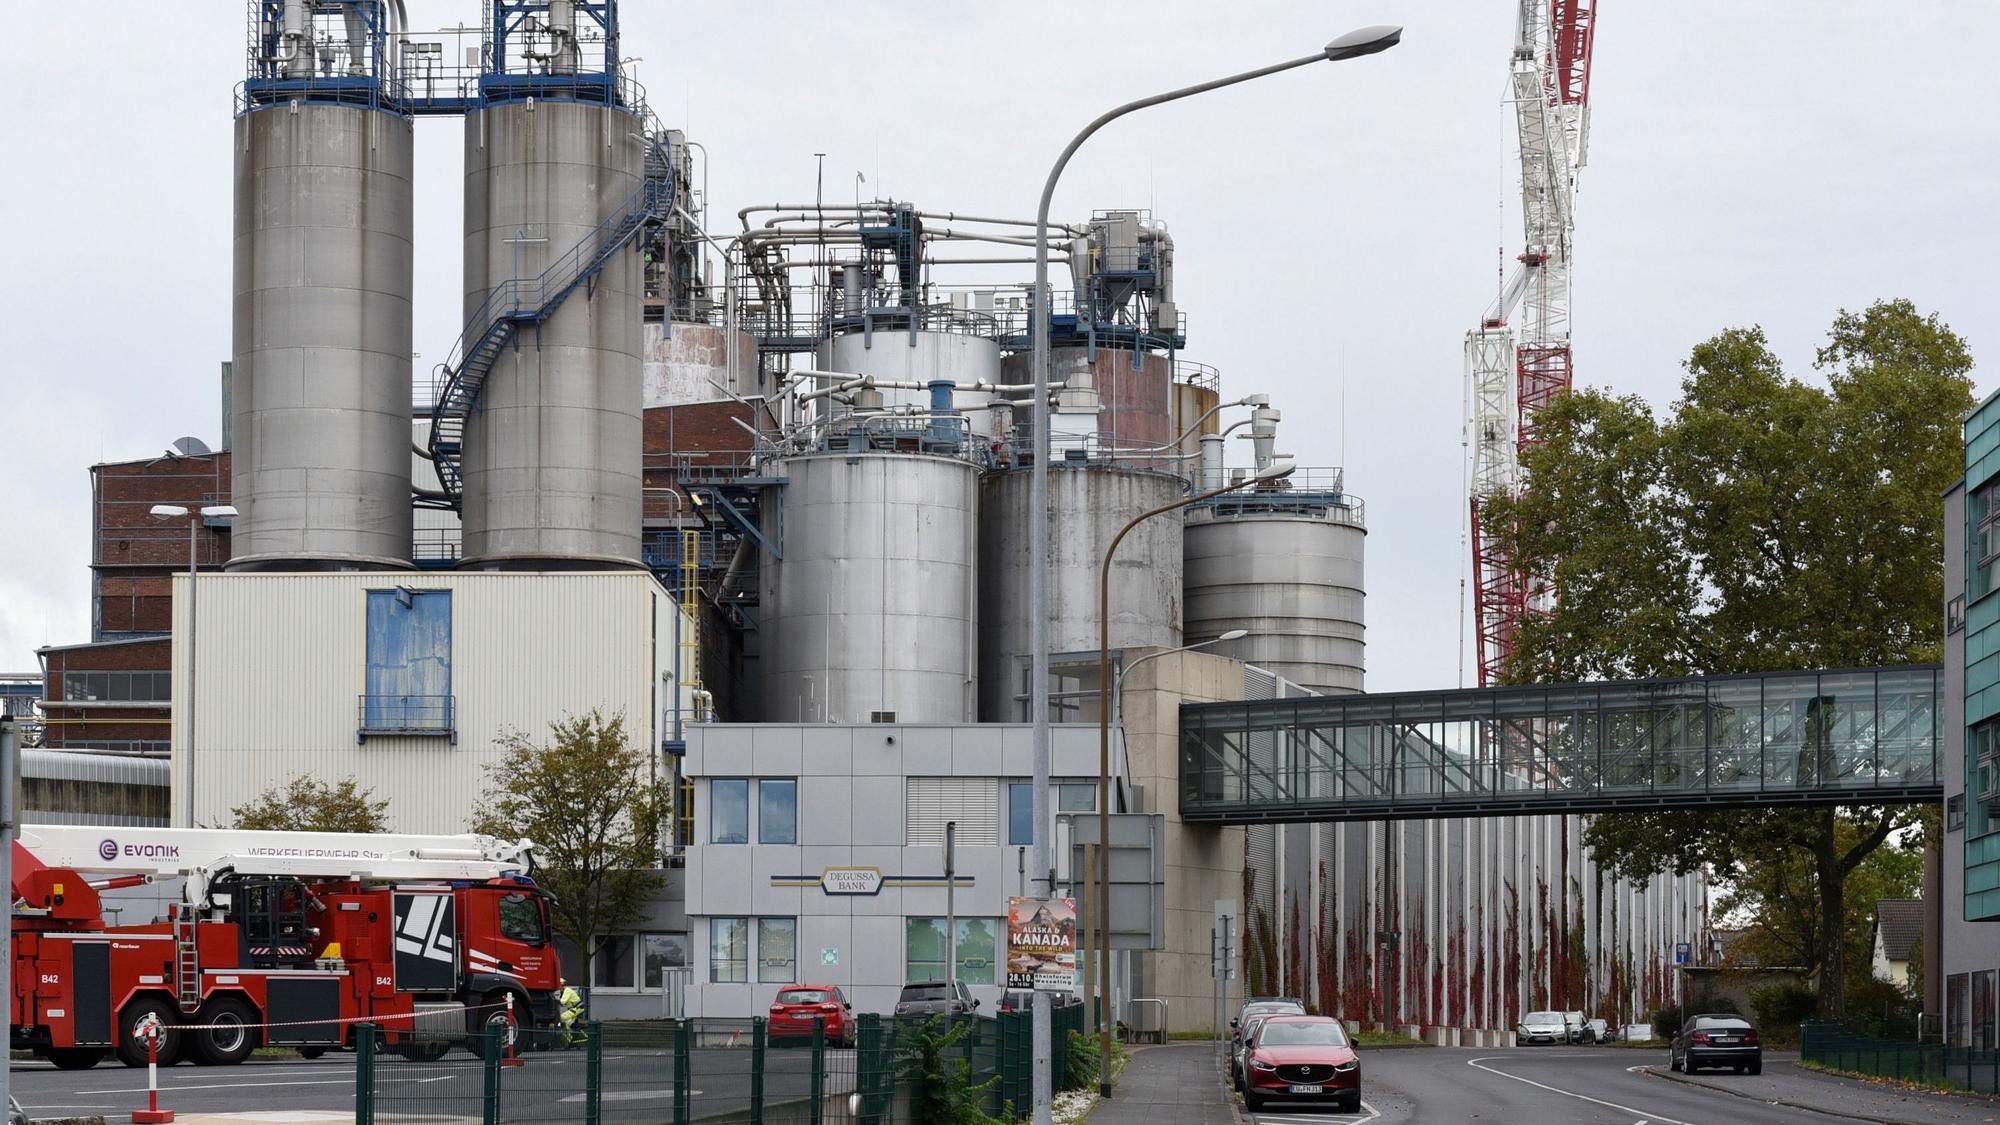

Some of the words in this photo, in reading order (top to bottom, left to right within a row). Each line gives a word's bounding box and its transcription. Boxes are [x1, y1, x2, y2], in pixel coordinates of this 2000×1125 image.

[124, 845, 179, 857] EVONIK
[830, 872, 875, 880] DEGUSSA
[838, 881, 866, 890] BANK
[1022, 926, 1052, 934] ALASKA
[1012, 933, 1070, 946] KANADA
[41, 974, 58, 983] B42
[376, 976, 391, 985] B42
[1009, 973, 1033, 982] 28.10.
